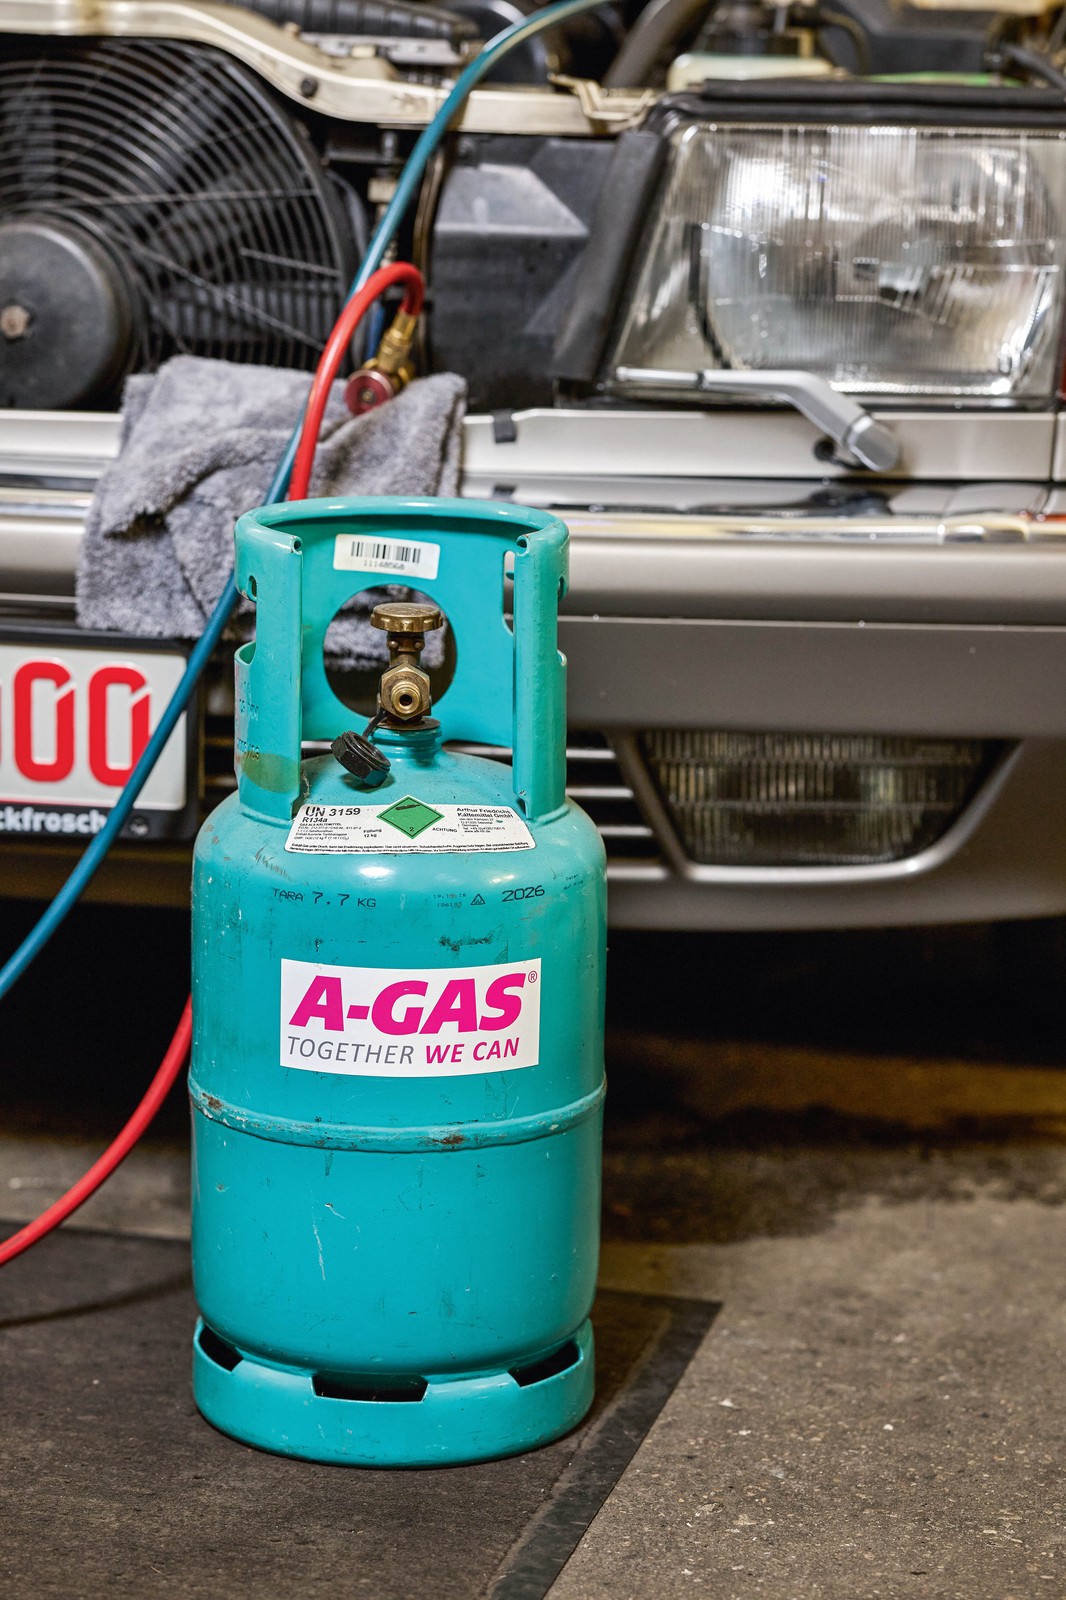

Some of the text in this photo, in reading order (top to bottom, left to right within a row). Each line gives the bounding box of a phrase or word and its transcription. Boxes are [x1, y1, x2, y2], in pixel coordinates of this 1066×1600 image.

[305, 806, 361, 817] UN 3159
[272, 887, 377, 908] TARA 7.7 KG
[502, 884, 545, 902] 2026
[288, 1036, 520, 1065] TOGETHER WE CAN
